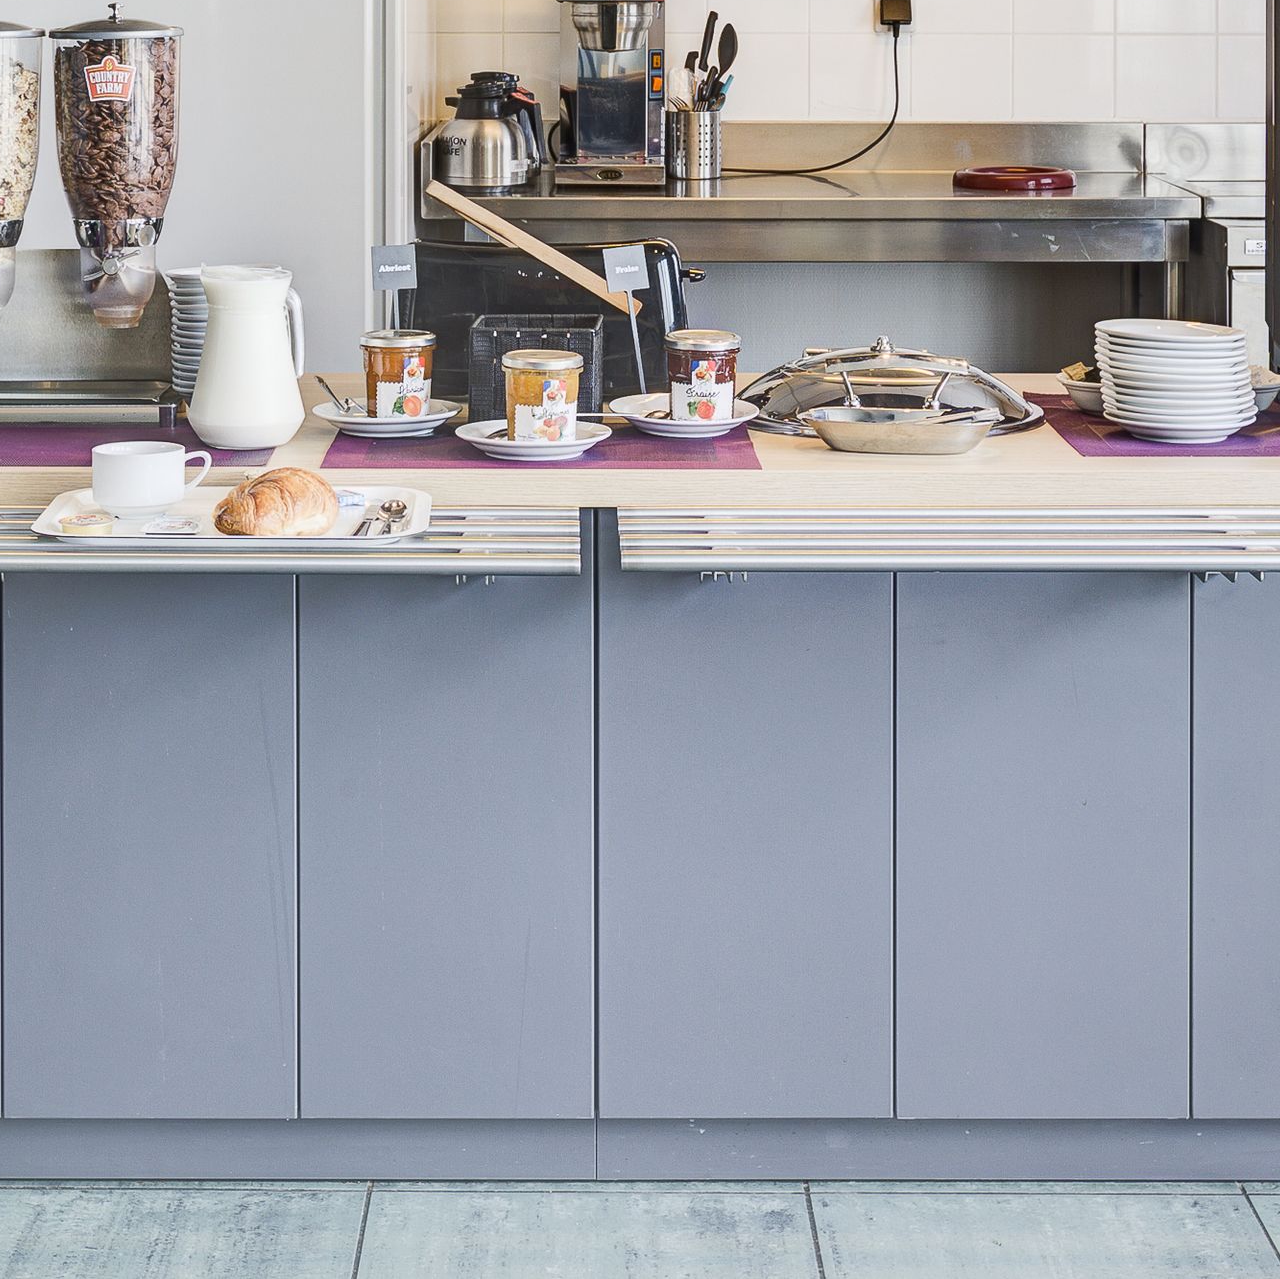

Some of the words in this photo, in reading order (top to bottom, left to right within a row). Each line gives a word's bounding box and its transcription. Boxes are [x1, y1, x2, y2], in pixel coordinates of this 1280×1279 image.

[89, 71, 130, 84] COUNTRY
[96, 82, 122, 94] FARM
[378, 263, 412, 273] Abricot
